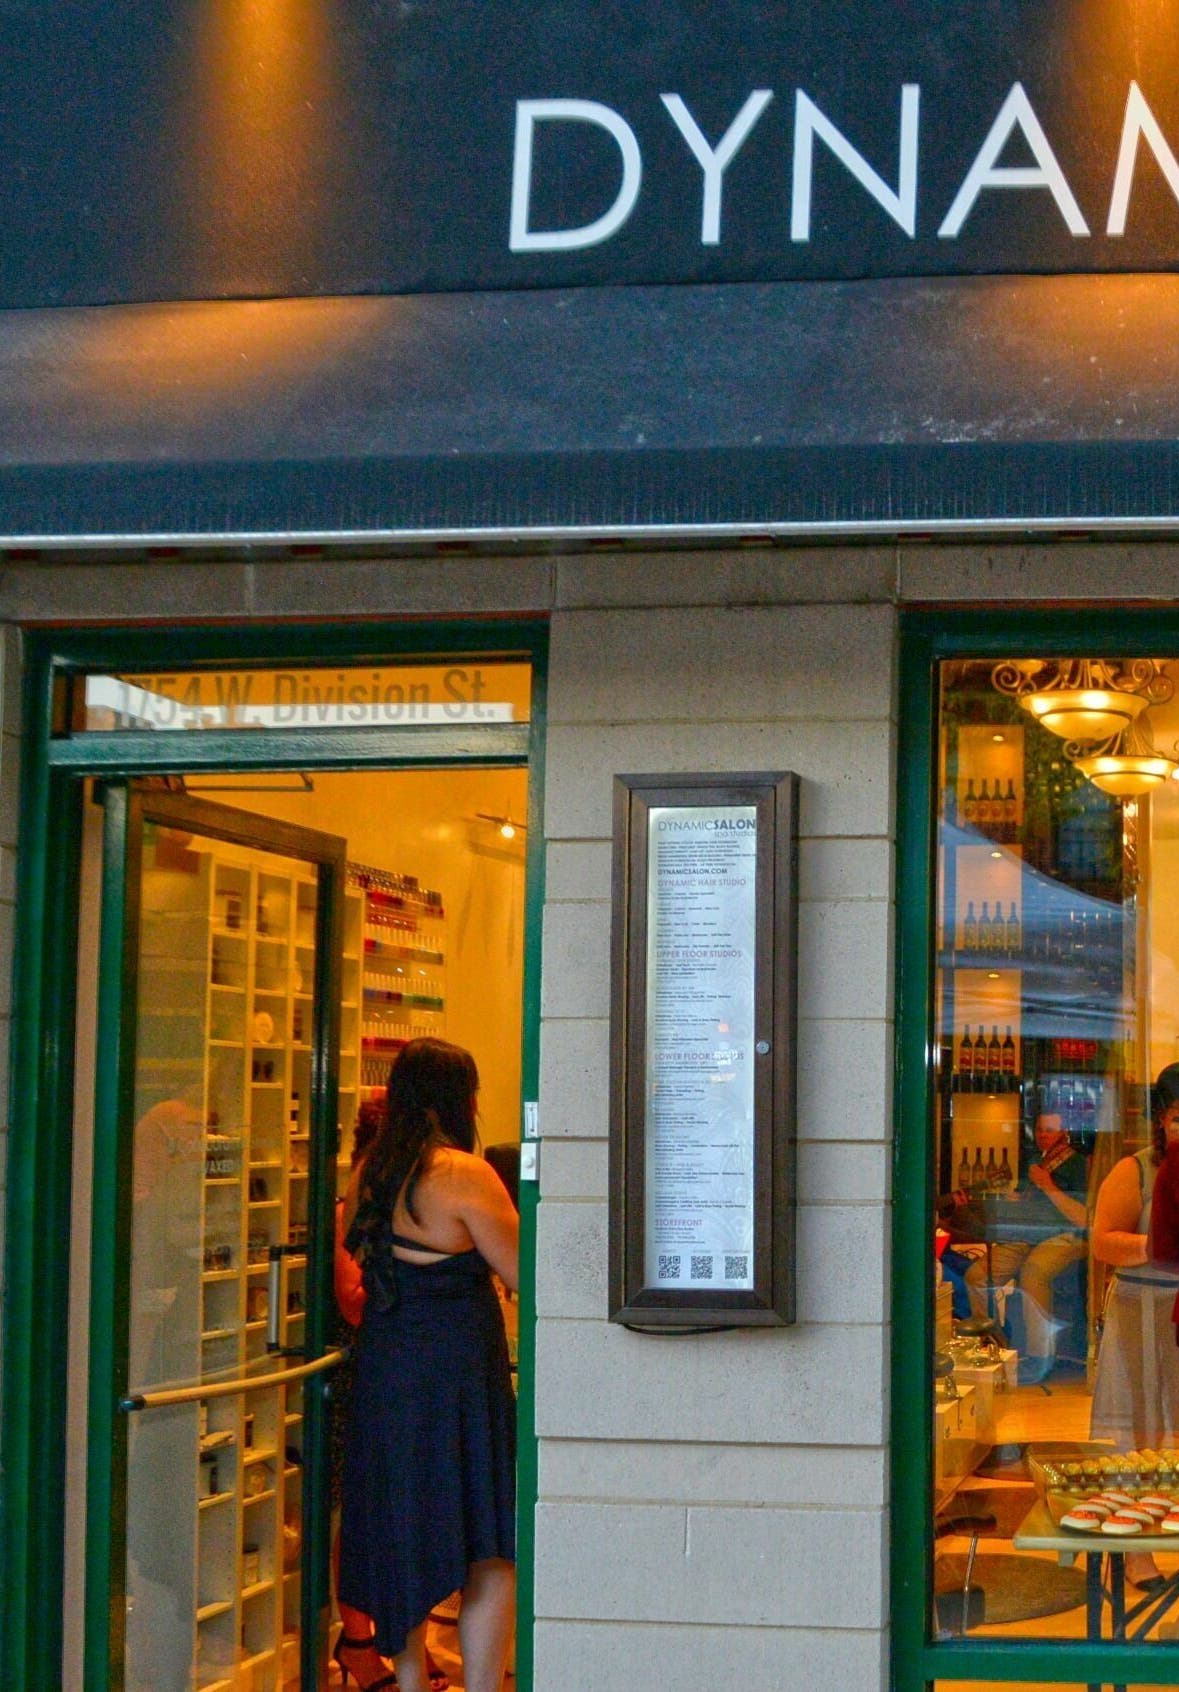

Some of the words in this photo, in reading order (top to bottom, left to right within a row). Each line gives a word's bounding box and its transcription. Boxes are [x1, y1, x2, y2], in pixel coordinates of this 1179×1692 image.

[117, 677, 214, 728] 1754
[273, 672, 429, 723] Division
[442, 668, 496, 719] St.
[719, 878, 747, 887] STUDIO
